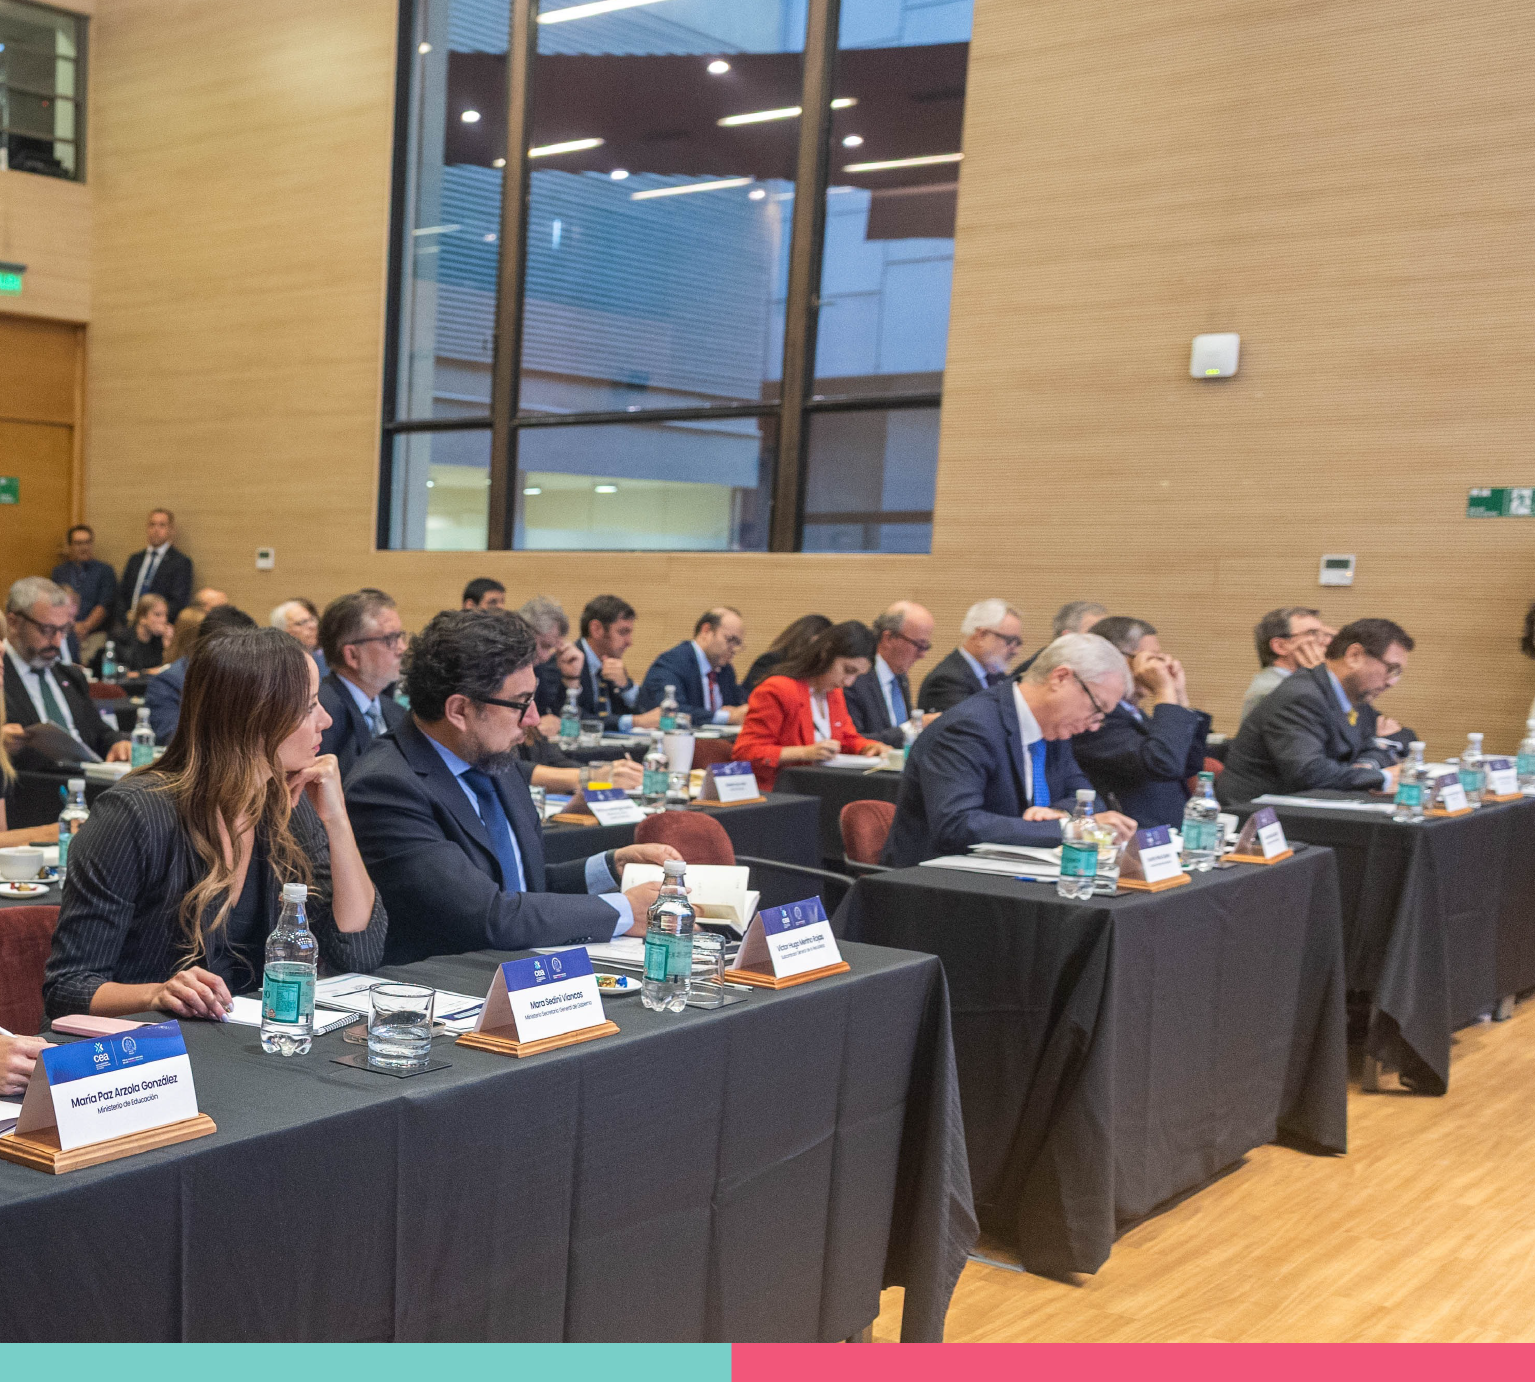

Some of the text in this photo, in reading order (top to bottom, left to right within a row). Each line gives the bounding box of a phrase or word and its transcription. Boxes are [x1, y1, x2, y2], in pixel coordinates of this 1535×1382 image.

[530, 1001, 545, 1009] Mara
[93, 1053, 109, 1062] cea
[71, 1074, 178, 1108] María Paz Arzola González
[98, 1094, 158, 1114] Ministerio de Educación
